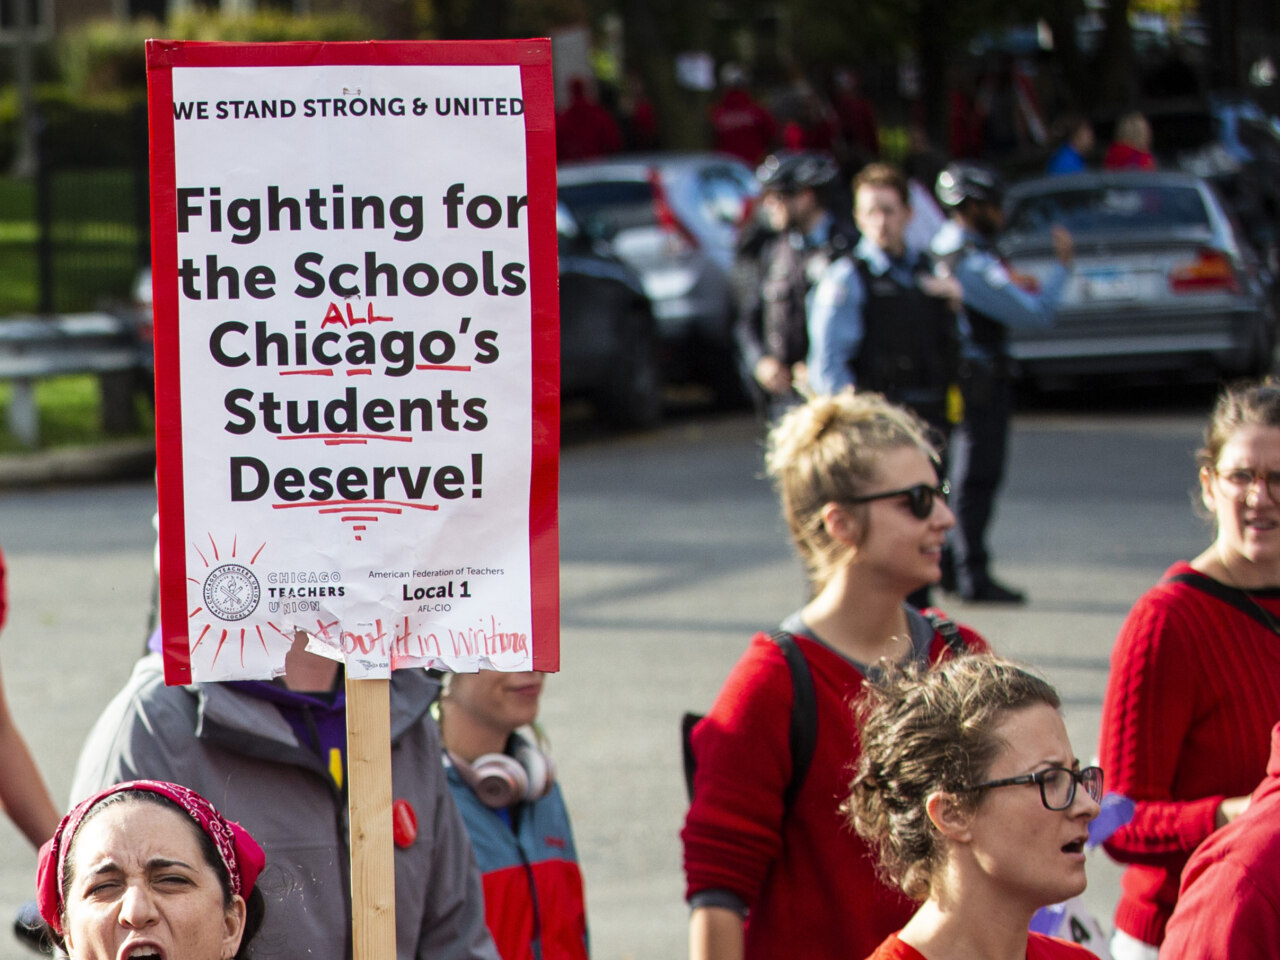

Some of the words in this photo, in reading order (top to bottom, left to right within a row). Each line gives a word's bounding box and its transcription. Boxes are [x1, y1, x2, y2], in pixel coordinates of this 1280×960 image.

[173, 101, 209, 120] WE
[215, 99, 297, 119] STAND
[303, 97, 406, 117] STRONG
[412, 97, 429, 115] &
[435, 97, 525, 116] UNITED
[177, 184, 424, 245] Fighting
[442, 183, 528, 229] for
[177, 254, 276, 300] the
[294, 250, 527, 299] Schools
[320, 302, 394, 329] ALL
[223, 387, 488, 435] Students
[230, 453, 483, 501] Deserve!
[267, 571, 342, 584] CHICAGO
[368, 570, 410, 579] American
[412, 568, 454, 578] Federation
[455, 567, 464, 576] of
[466, 567, 505, 576] Teachers
[267, 586, 346, 599] TEACHERS
[402, 581, 454, 601] Local
[459, 581, 472, 598] 1
[269, 601, 320, 615] UNION
[417, 604, 452, 613] AFL-CIO
